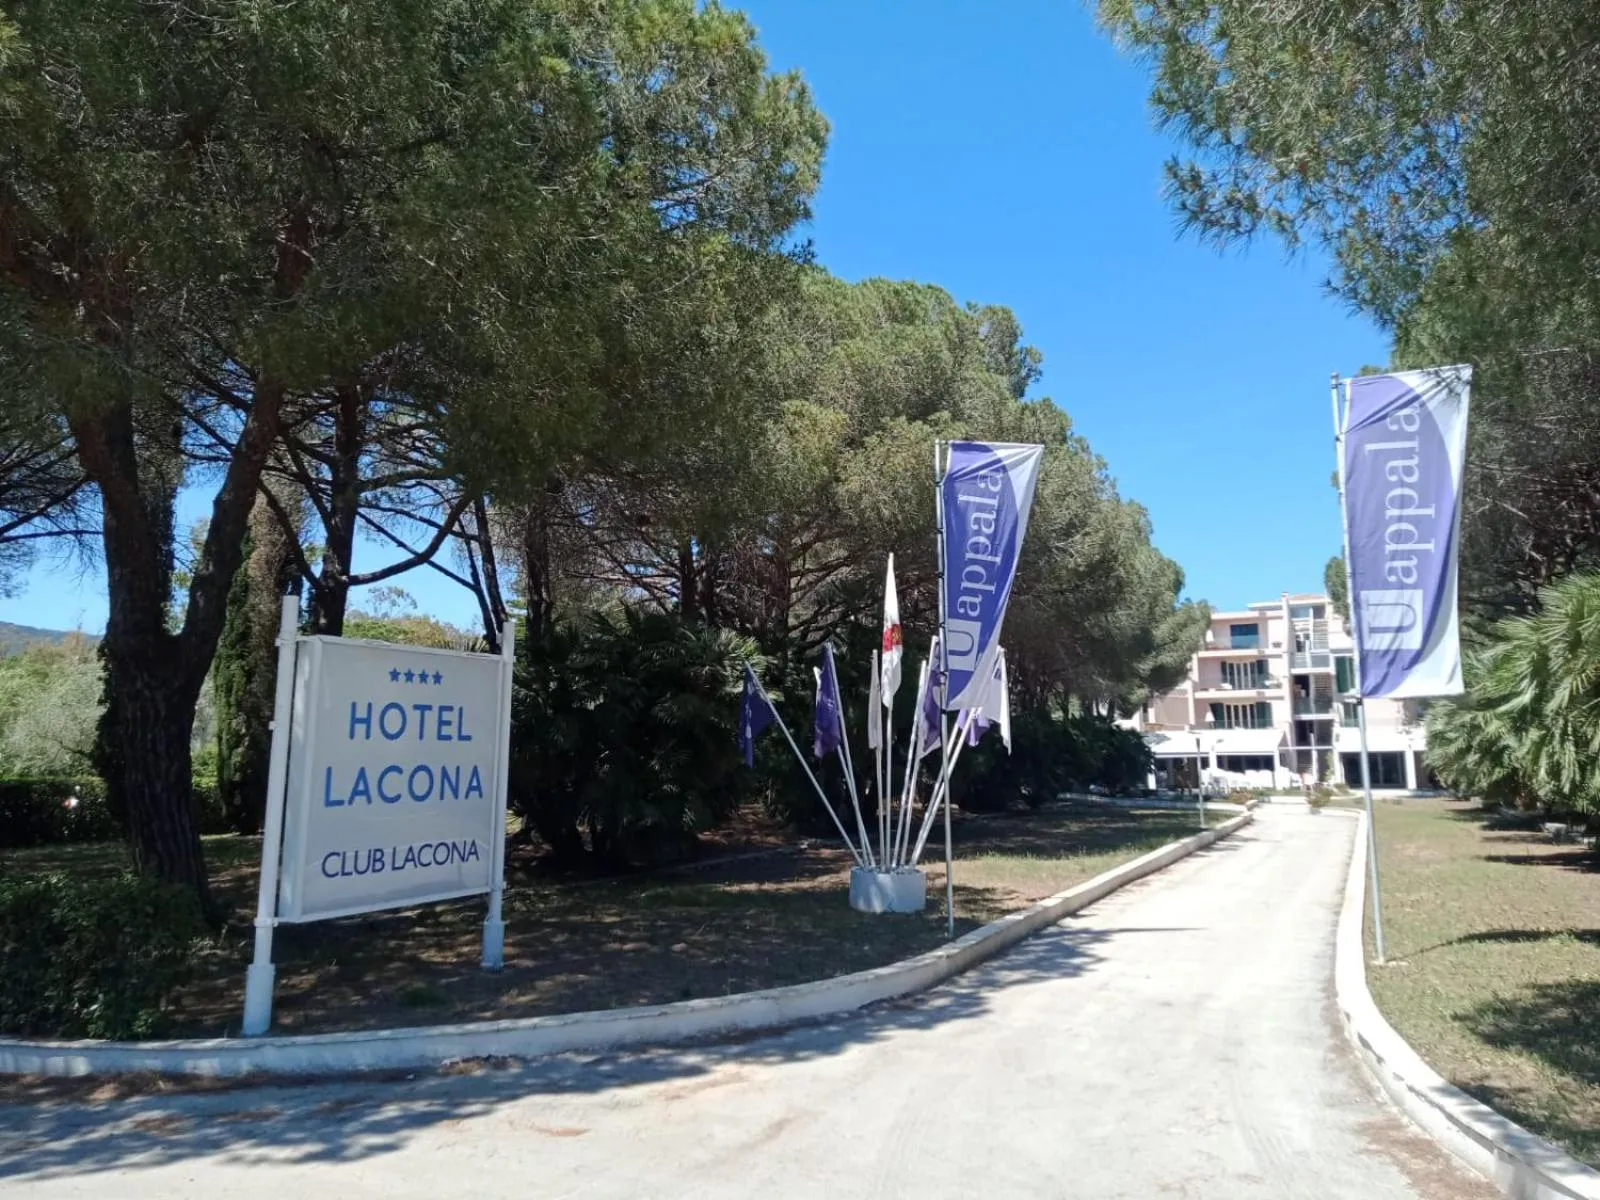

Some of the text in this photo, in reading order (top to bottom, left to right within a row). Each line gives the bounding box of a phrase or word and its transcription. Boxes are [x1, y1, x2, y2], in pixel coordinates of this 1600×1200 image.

[1364, 403, 1436, 636] Uappala
[947, 468, 1003, 660] Uappala
[349, 701, 472, 742] HOTEL
[324, 764, 483, 807] LACONA
[321, 839, 480, 878] CLUB LACONA
